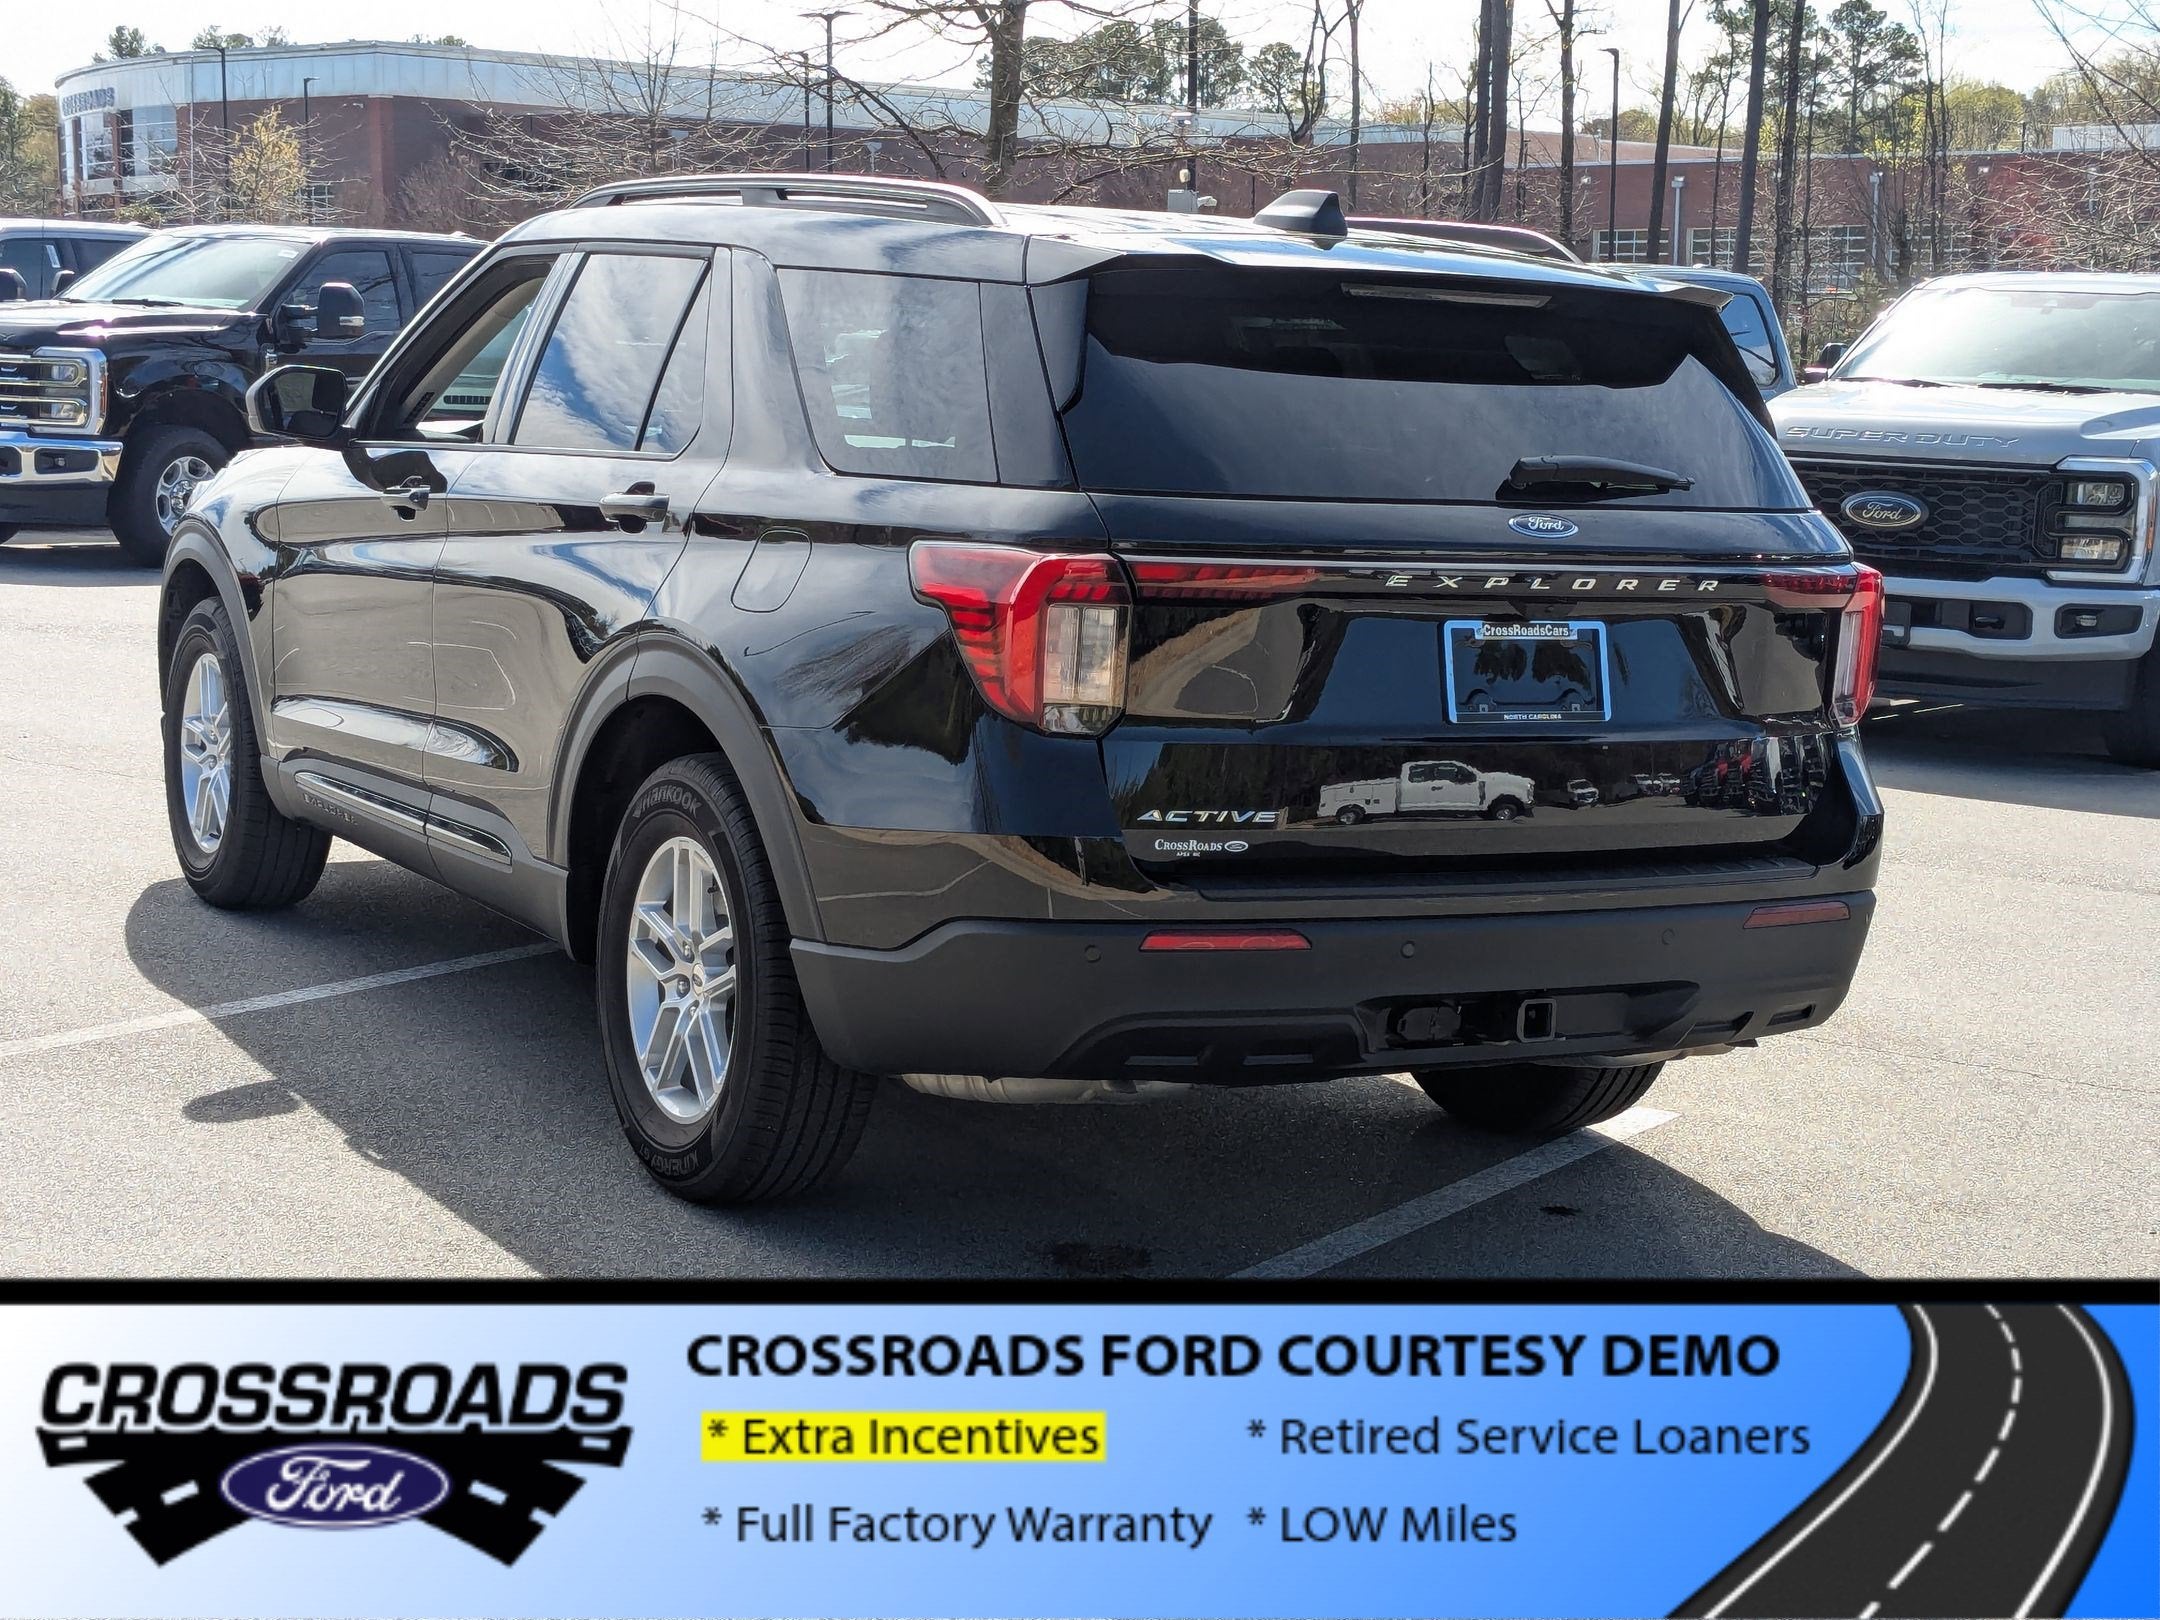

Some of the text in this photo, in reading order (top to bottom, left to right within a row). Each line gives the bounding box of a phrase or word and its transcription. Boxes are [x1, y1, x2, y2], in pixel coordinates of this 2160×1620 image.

[1786, 426, 2020, 448] SUPER DUTY
[1862, 501, 1903, 520] Ford
[1527, 515, 1565, 532] Ford
[1385, 574, 1720, 593] EXPLORER
[1483, 623, 1570, 637] CrossRoadsCars
[1136, 809, 1281, 823] ACTIVE
